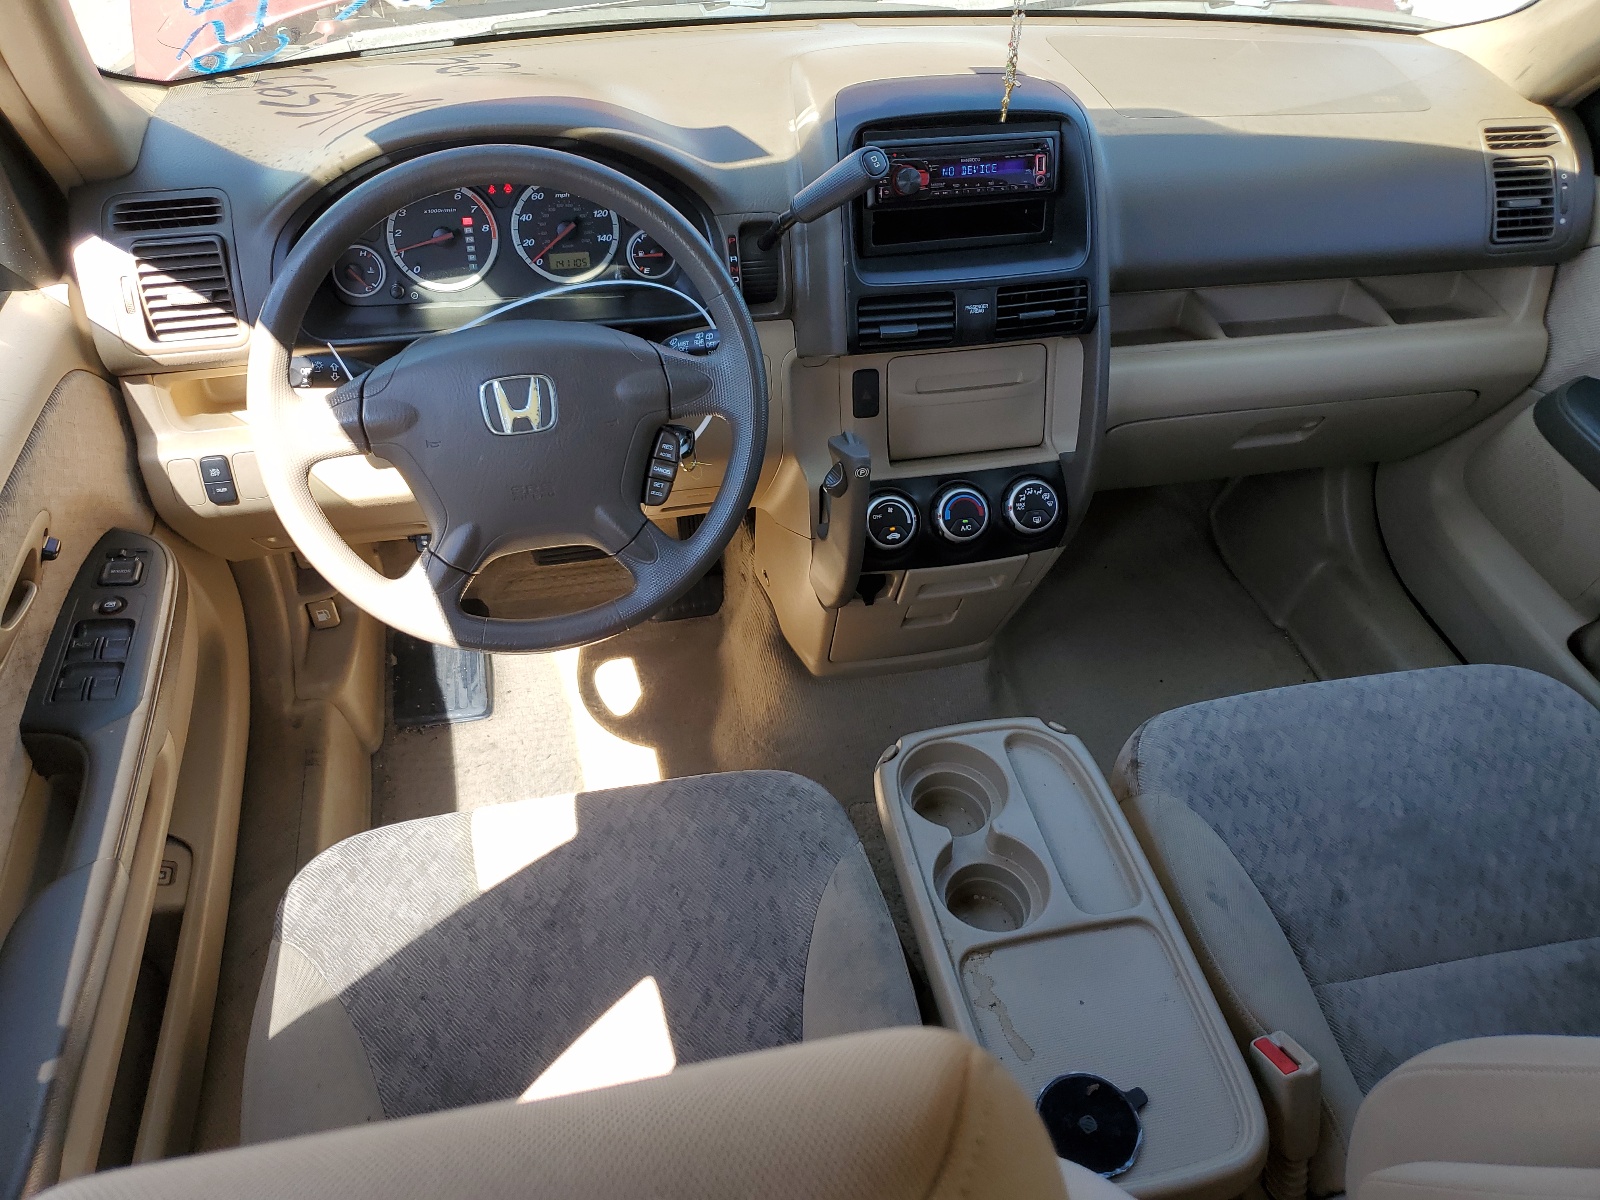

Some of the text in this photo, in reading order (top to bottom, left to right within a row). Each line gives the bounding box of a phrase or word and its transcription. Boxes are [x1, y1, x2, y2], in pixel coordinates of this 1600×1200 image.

[942, 166, 955, 176] NO
[961, 163, 997, 176] DEVICE
[454, 192, 462, 200] 6
[531, 192, 544, 200] 60
[398, 209, 406, 217] 3
[471, 205, 478, 213] 7
[520, 213, 533, 221] 40
[593, 209, 609, 218] 120
[481, 224, 490, 232] 8
[394, 229, 402, 237] 2
[523, 238, 535, 246] 20
[597, 234, 612, 242] 140
[536, 258, 544, 266] 0
[555, 258, 588, 268] 141105
[413, 265, 421, 273] 0
[960, 524, 972, 532] A/C
